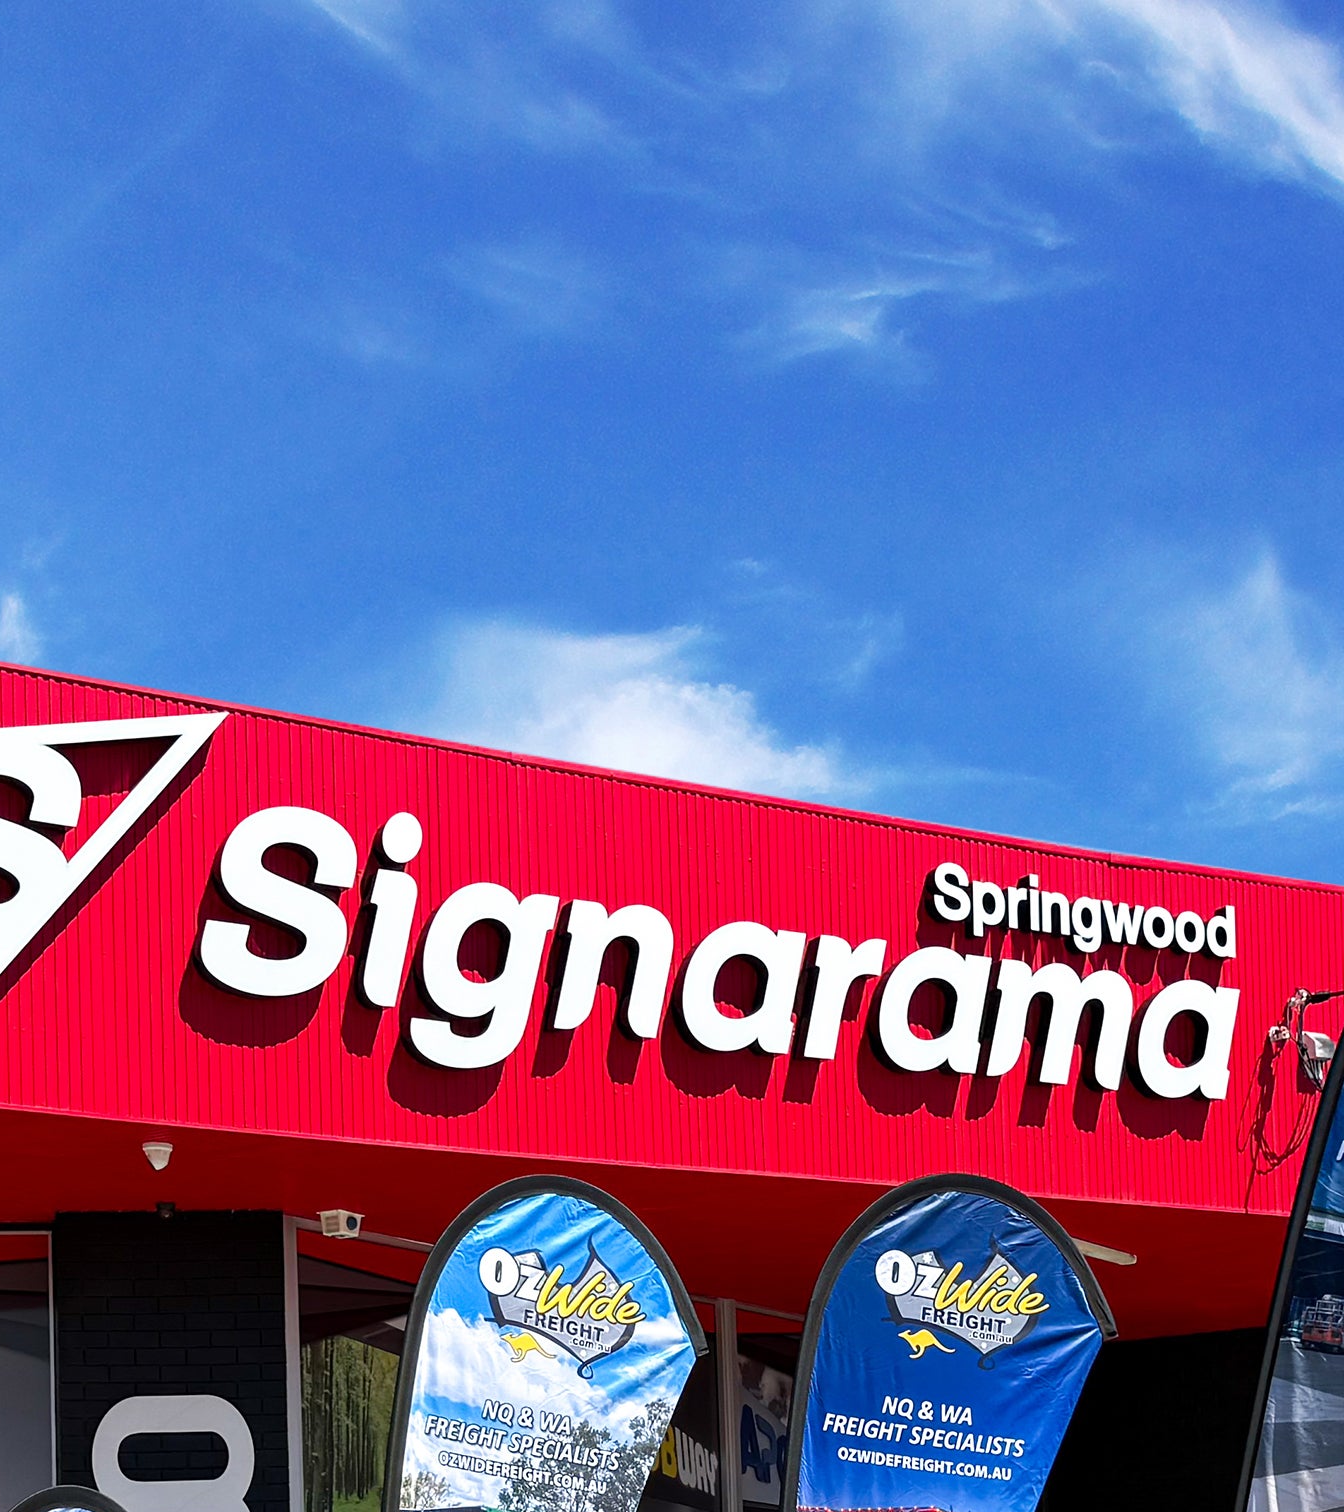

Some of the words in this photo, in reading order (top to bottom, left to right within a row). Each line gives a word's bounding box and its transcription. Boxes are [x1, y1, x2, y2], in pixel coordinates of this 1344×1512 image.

[929, 861, 1239, 963] Springwood
[196, 806, 1234, 1102] Signarama
[523, 1308, 605, 1343] FREIGHT
[921, 1306, 1007, 1335] FREIGHT
[968, 1331, 1013, 1345] .com.au
[482, 1399, 514, 1427] NQ
[517, 1405, 536, 1427] &
[540, 1409, 573, 1436] WA
[881, 1395, 914, 1422] NQ
[917, 1400, 934, 1420] &
[940, 1402, 974, 1426] WA
[424, 1414, 509, 1452] FREIGHT
[507, 1430, 622, 1472] SPECIALISTS
[822, 1413, 908, 1445] FREIGHT
[911, 1426, 1025, 1458] SPECIALISTS
[438, 1451, 608, 1495] OZWIDEFREIGHT.COM.AU
[837, 1447, 1013, 1482] OZWIDEFREIGHT.COM.AU
